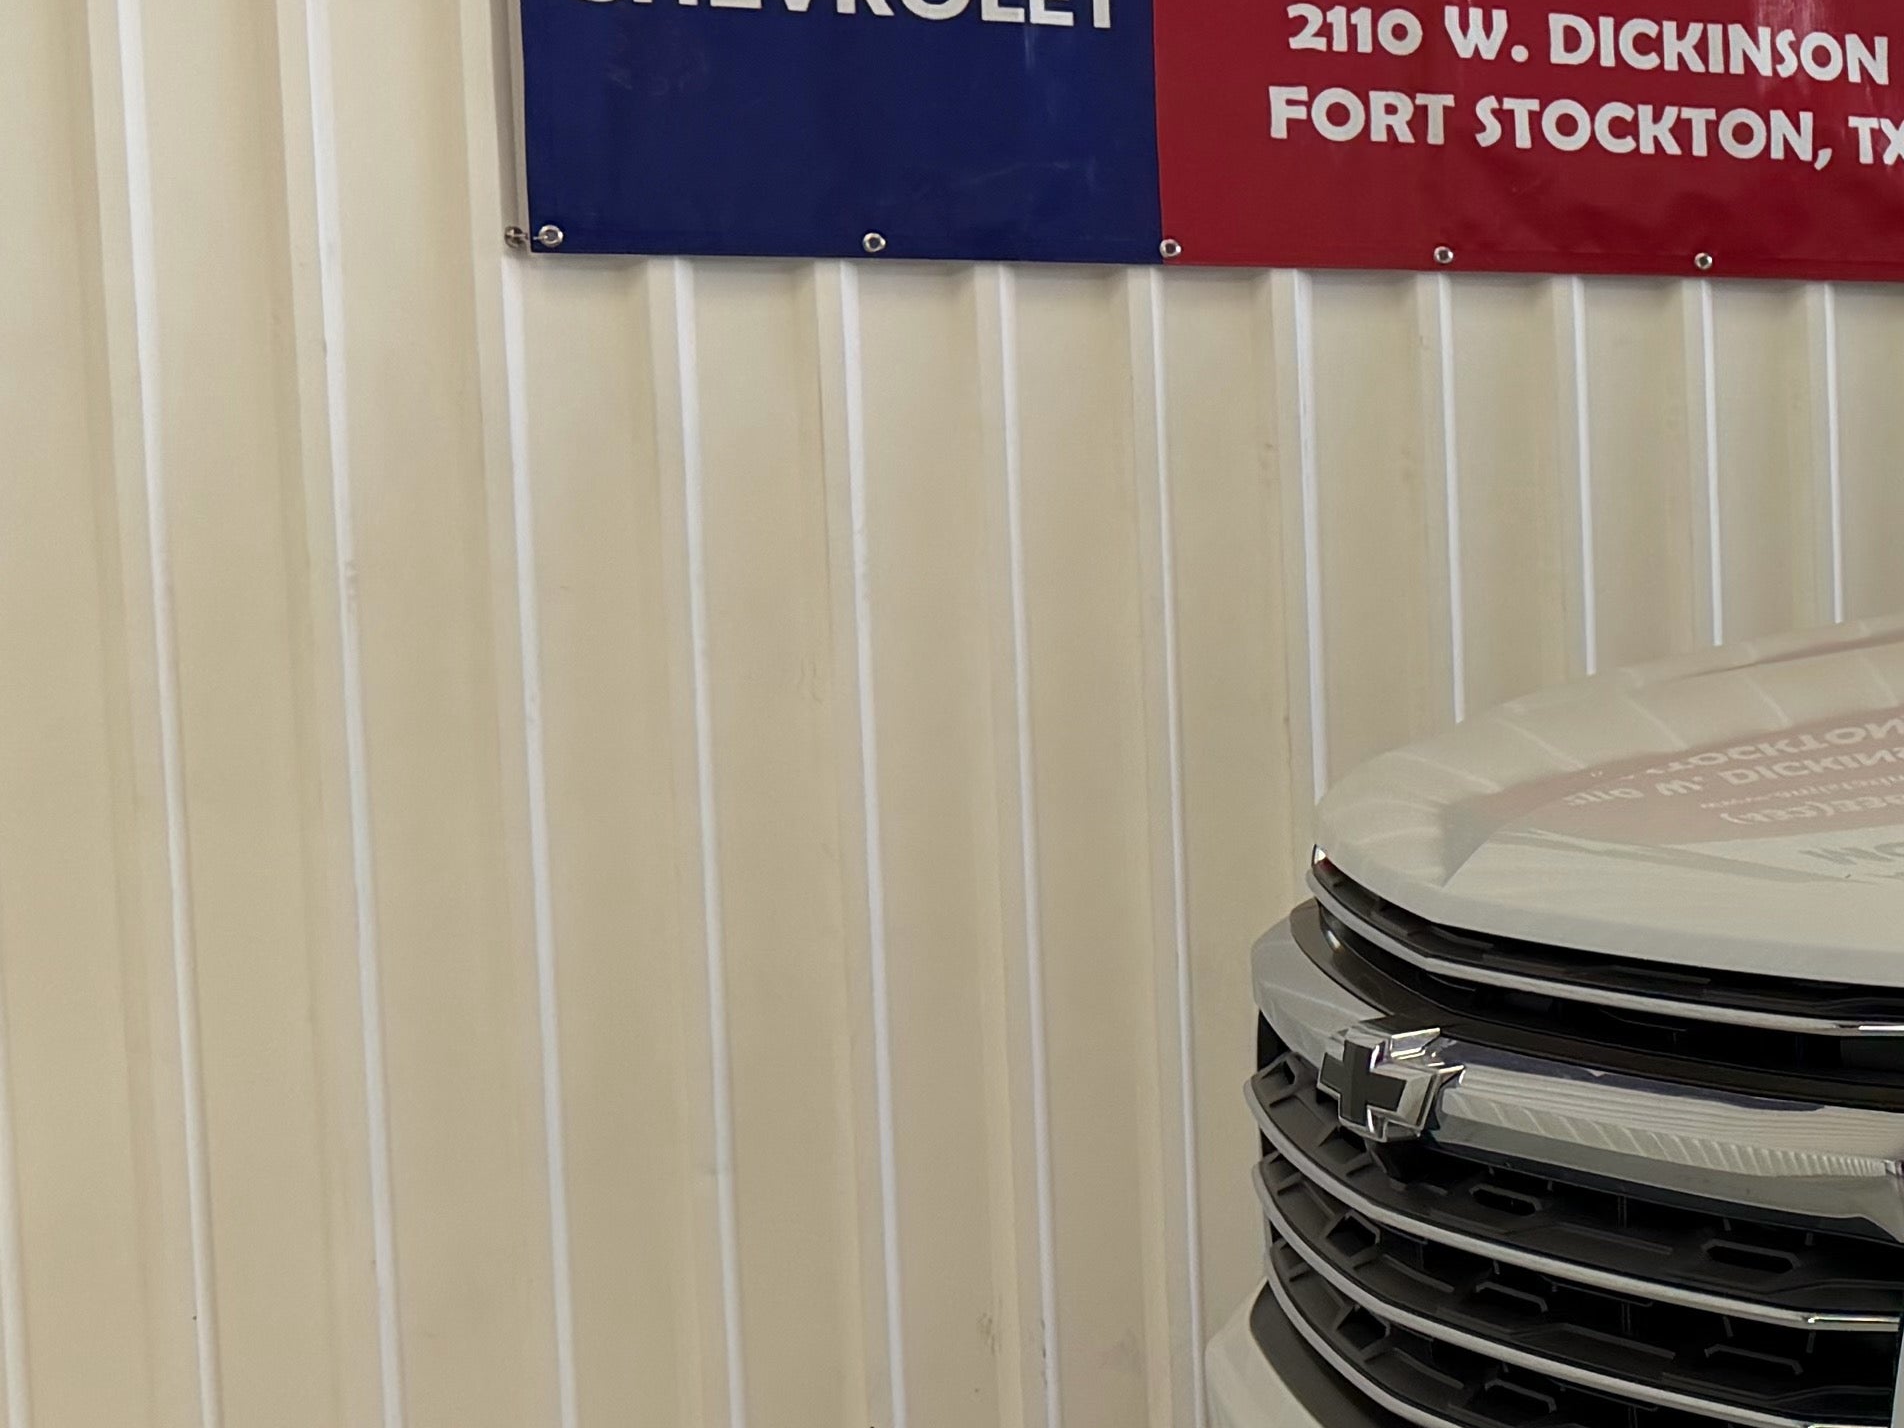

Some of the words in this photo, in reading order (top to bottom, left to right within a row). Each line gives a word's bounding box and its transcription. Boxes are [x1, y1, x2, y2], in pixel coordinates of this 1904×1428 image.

[1287, 3, 1423, 56] 2110
[1444, 5, 1529, 63] W.
[1548, 13, 1889, 85] DICKINSON
[1269, 85, 1455, 145] FORT
[1475, 96, 1832, 170] STOCKTON,
